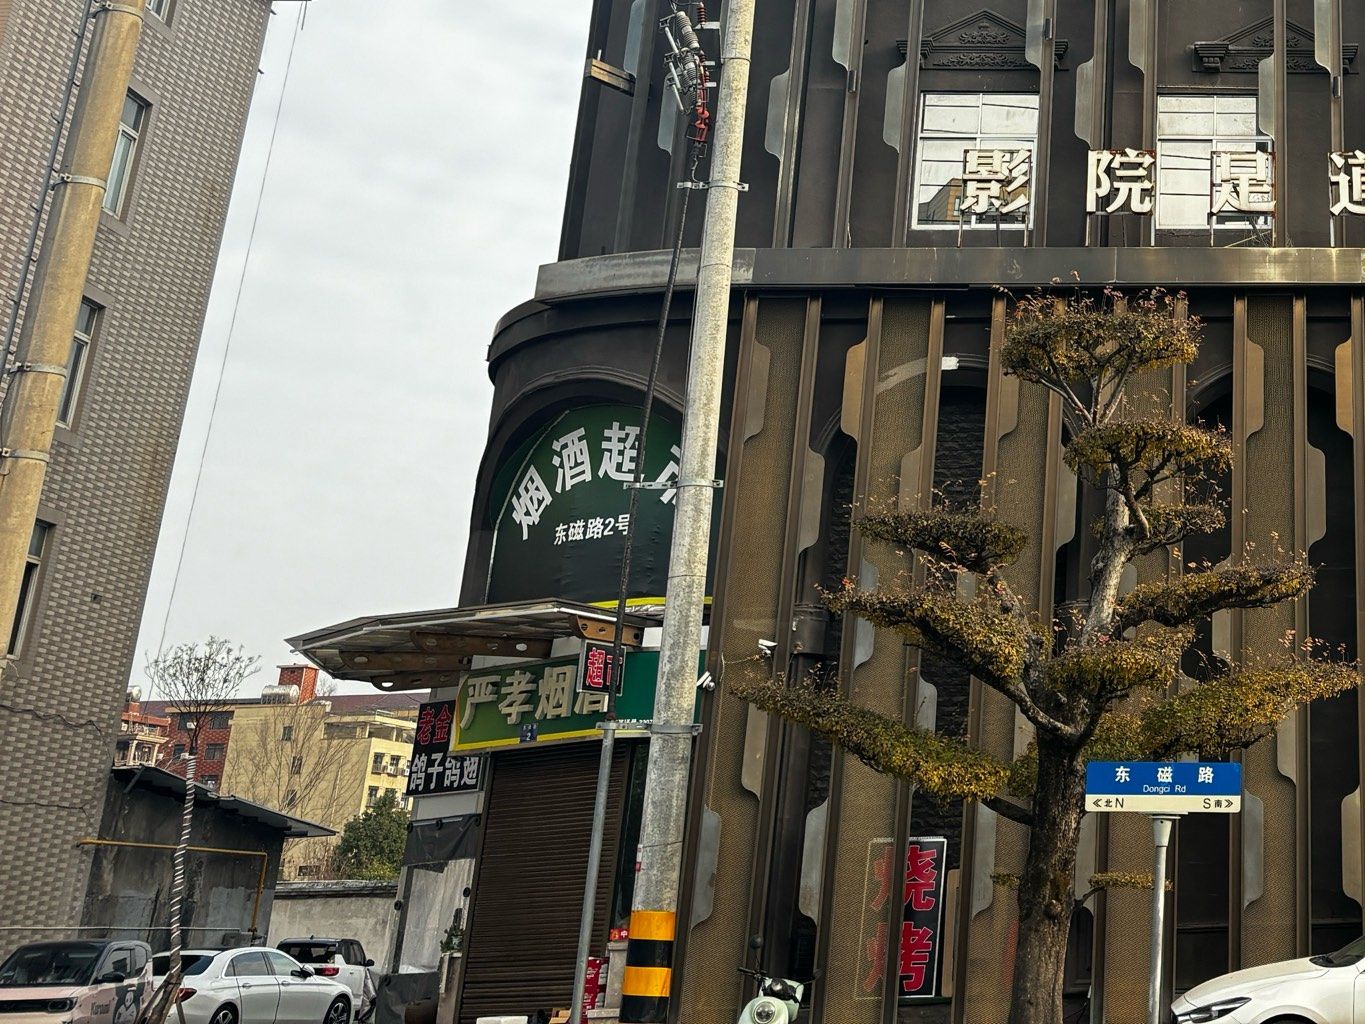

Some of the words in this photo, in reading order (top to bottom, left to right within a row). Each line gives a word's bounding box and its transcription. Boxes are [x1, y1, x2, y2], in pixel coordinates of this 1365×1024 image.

[554, 513, 630, 545] 东磁路2号
[417, 704, 452, 745] 老金
[1115, 765, 1214, 783] 东磁路
[1143, 785, 1170, 794] Dongci
[1174, 785, 1186, 793] Rd
